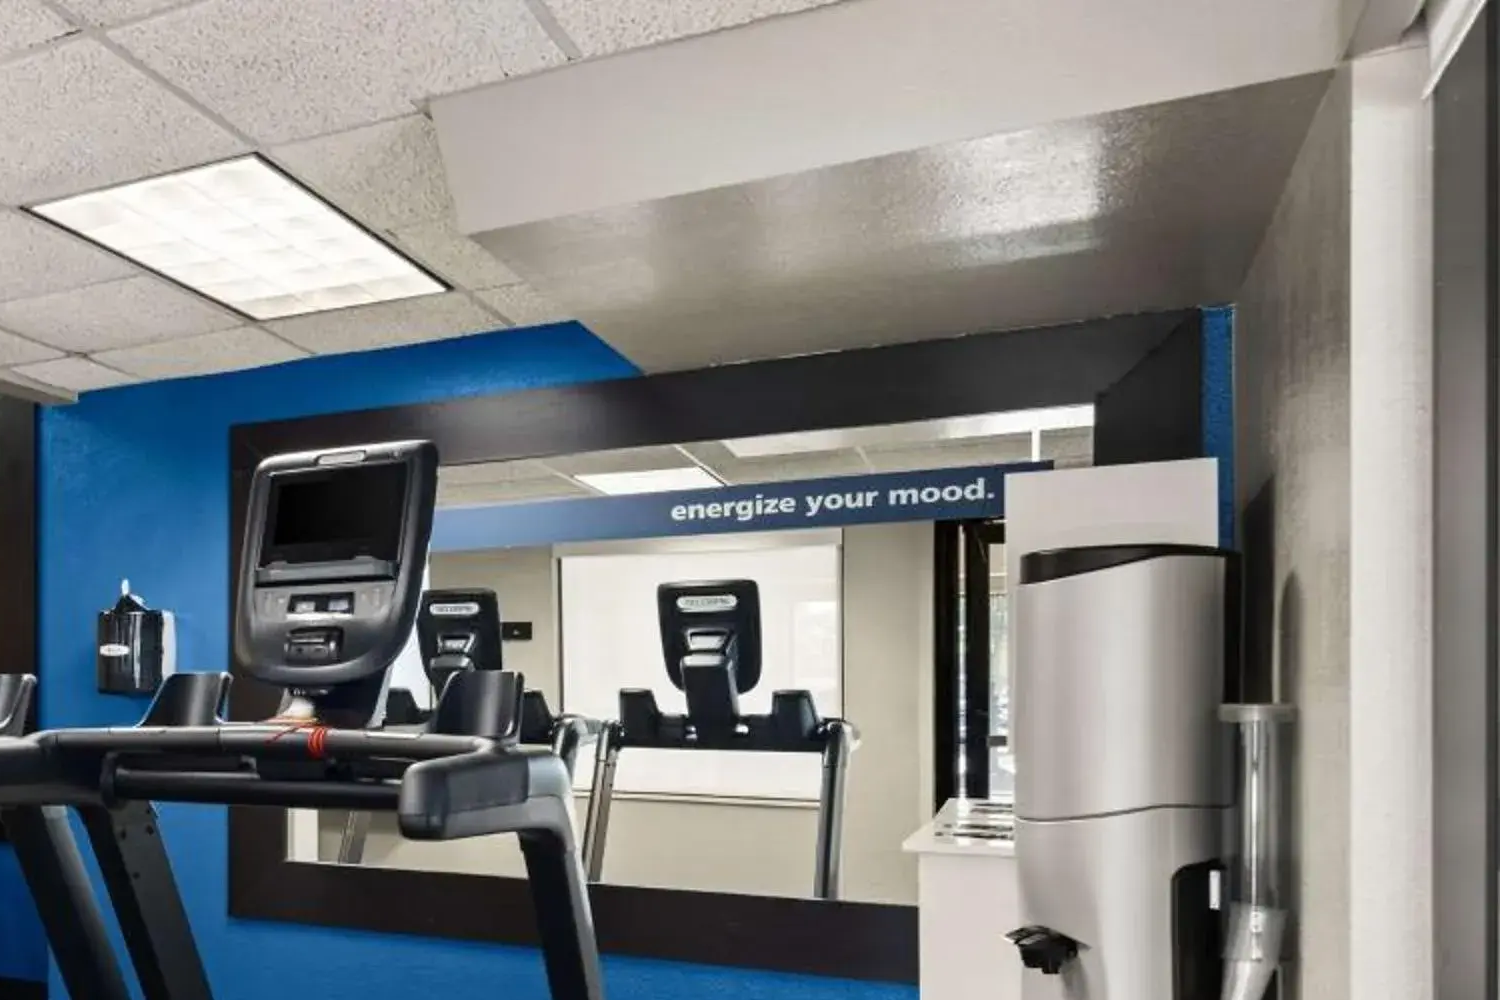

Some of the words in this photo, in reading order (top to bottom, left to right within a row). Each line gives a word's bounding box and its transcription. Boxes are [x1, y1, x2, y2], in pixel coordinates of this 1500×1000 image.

[670, 493, 797, 522] energize
[805, 489, 879, 517] your
[888, 477, 996, 506] mood.
